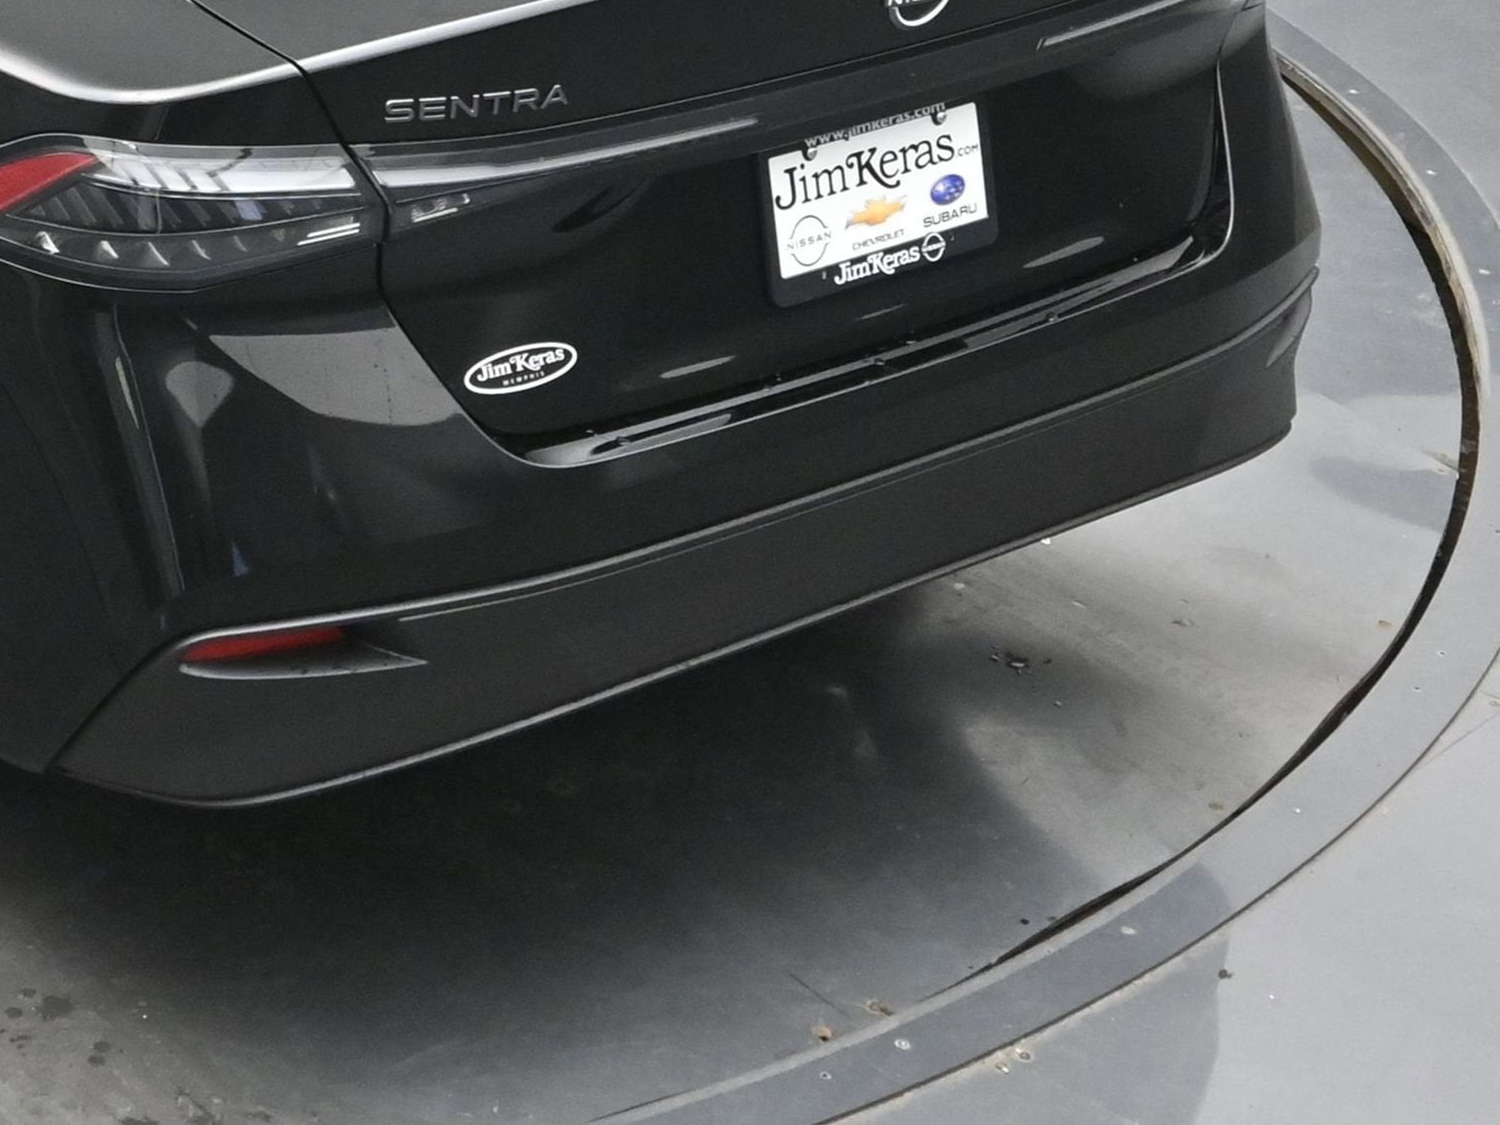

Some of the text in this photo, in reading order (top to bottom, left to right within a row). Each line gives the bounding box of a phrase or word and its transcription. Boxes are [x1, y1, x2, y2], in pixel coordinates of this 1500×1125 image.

[384, 83, 569, 123] SENTRA
[803, 101, 947, 148] www.jimkeras.com
[922, 202, 978, 228] SUBARU
[786, 230, 832, 251] NISSAN
[851, 228, 905, 251] CHEVROLET
